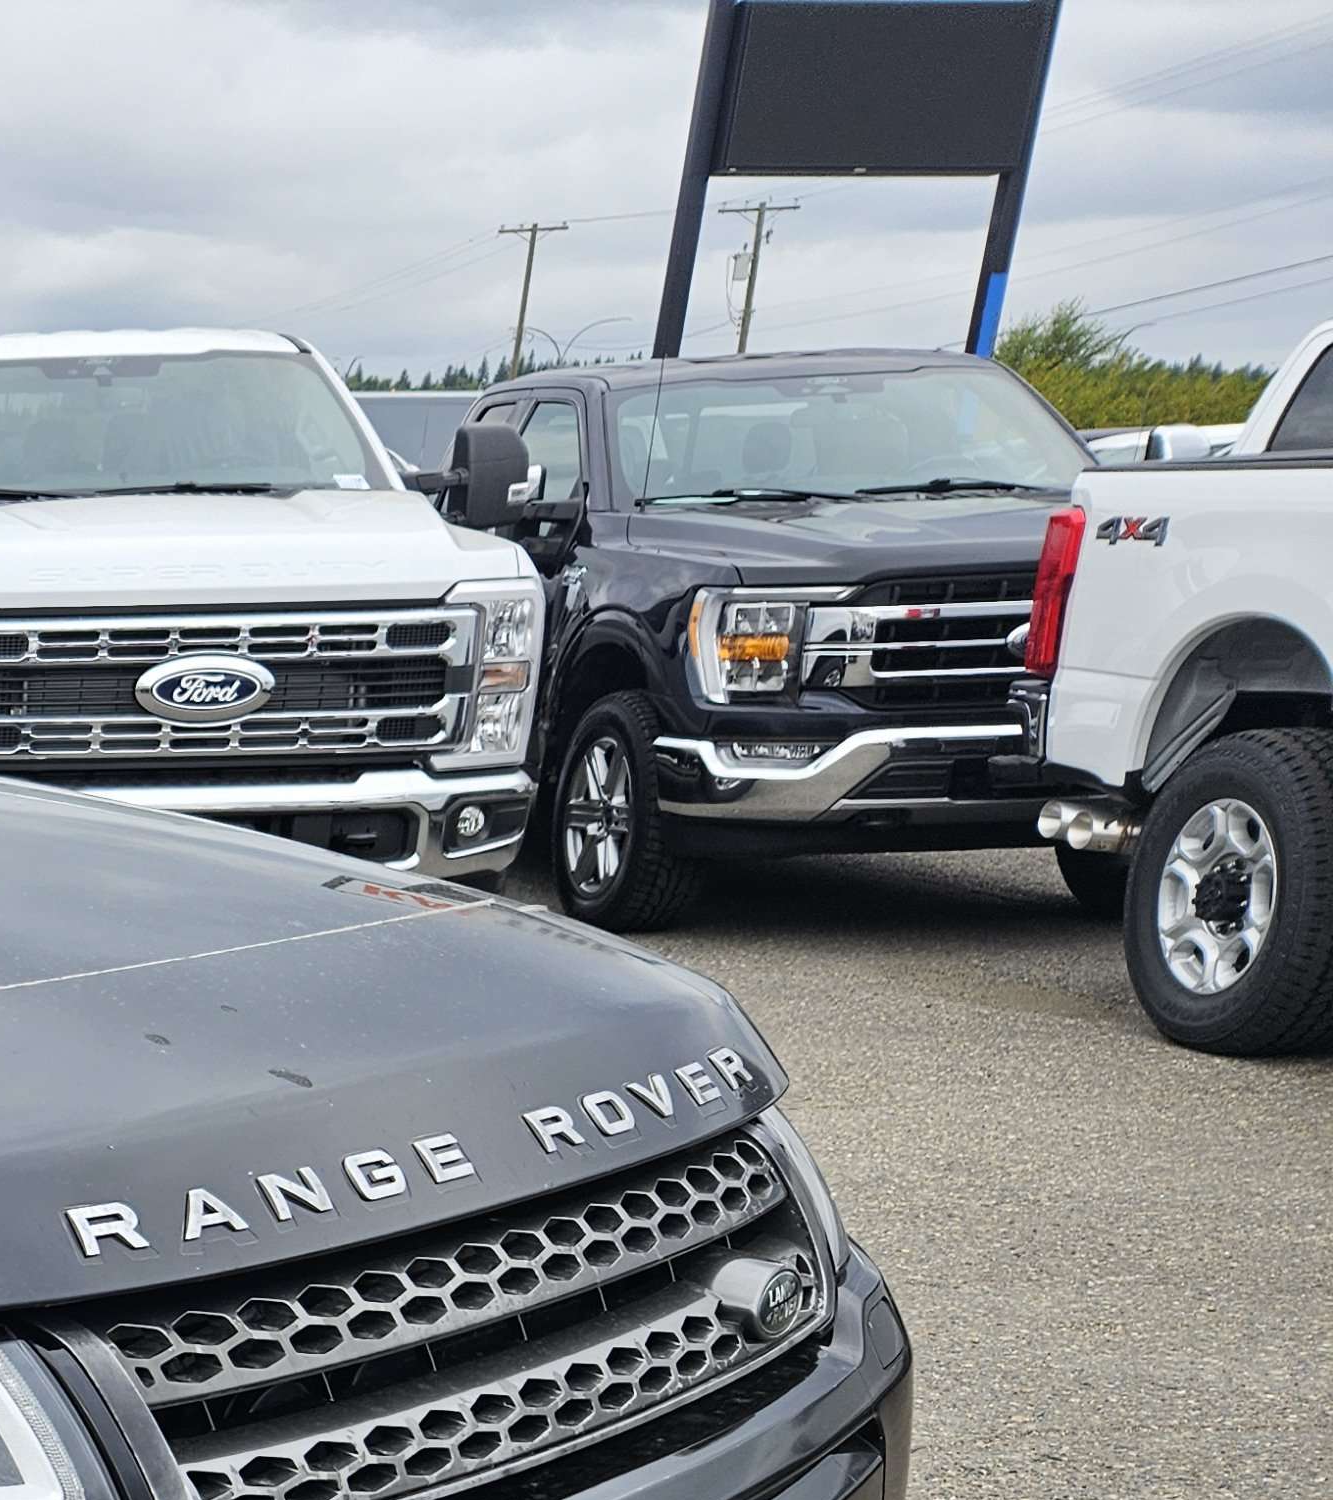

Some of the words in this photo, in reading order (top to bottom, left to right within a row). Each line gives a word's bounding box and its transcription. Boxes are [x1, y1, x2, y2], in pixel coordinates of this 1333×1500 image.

[171, 674, 239, 704] Ford
[64, 1131, 475, 1257] RANGE
[522, 1047, 754, 1153] ROVER
